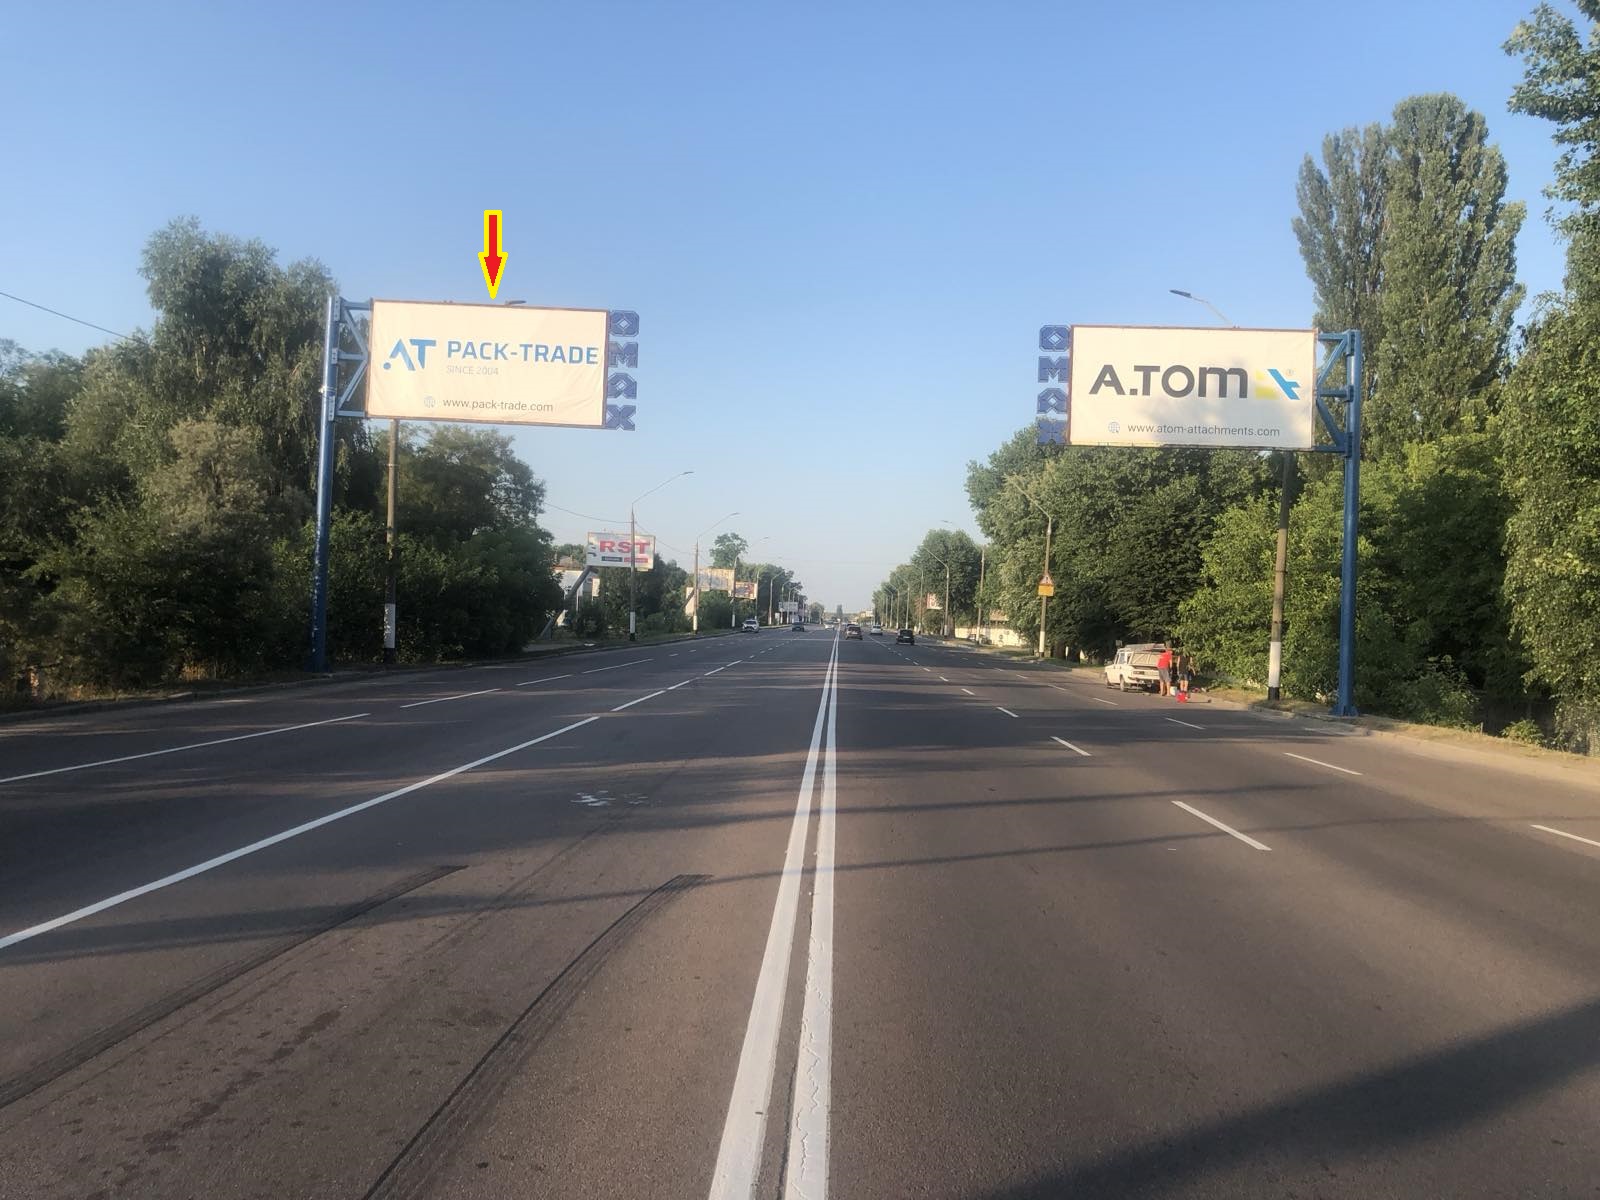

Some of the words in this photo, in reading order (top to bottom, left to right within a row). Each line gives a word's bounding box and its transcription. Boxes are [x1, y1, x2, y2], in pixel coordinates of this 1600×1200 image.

[447, 340, 599, 365] PACK-TRADE
[446, 364, 474, 375] SINCE
[476, 365, 499, 376] 2004
[442, 399, 554, 412] www.pack-trade.com
[1127, 423, 1281, 437] www.atom-attachments.com
[600, 540, 650, 554] RST
